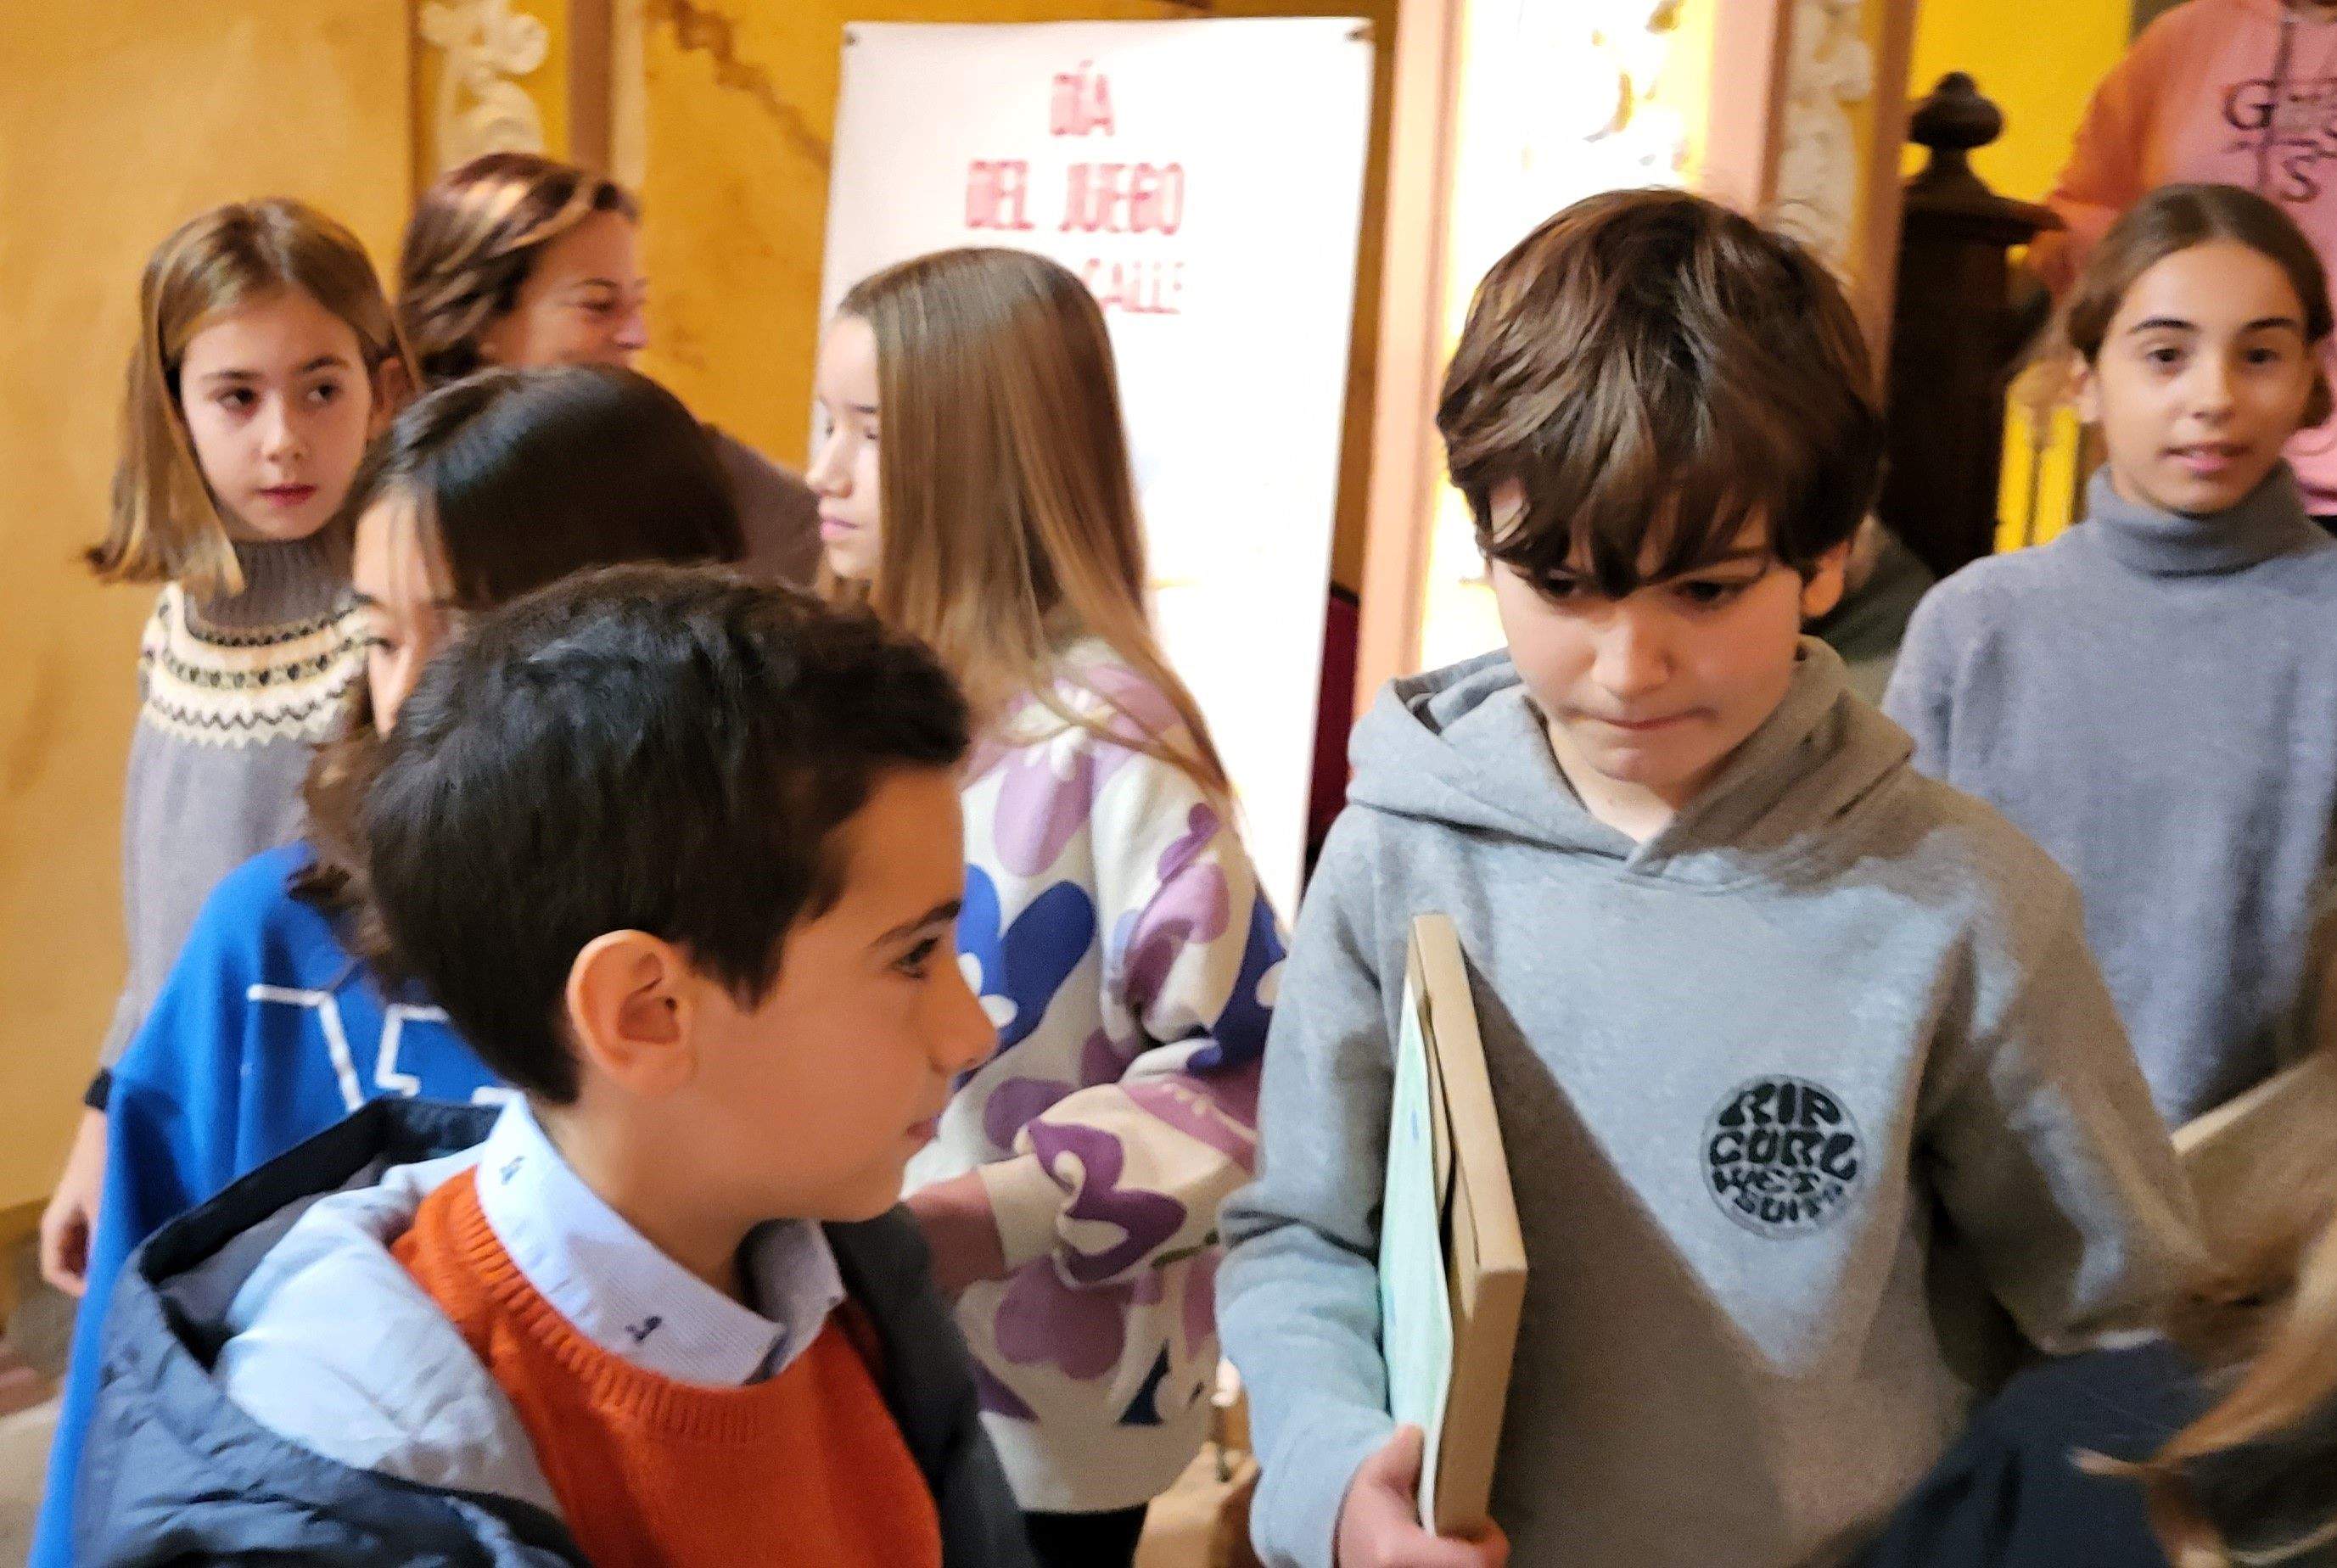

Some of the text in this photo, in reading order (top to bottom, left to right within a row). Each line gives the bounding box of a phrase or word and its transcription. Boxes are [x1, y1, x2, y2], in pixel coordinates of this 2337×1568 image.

[1049, 59, 1115, 137] DÍA
[965, 159, 1185, 235] DEL JUEGO
[1718, 1082, 1842, 1127] RIP
[1709, 1130, 1858, 1181] CURL
